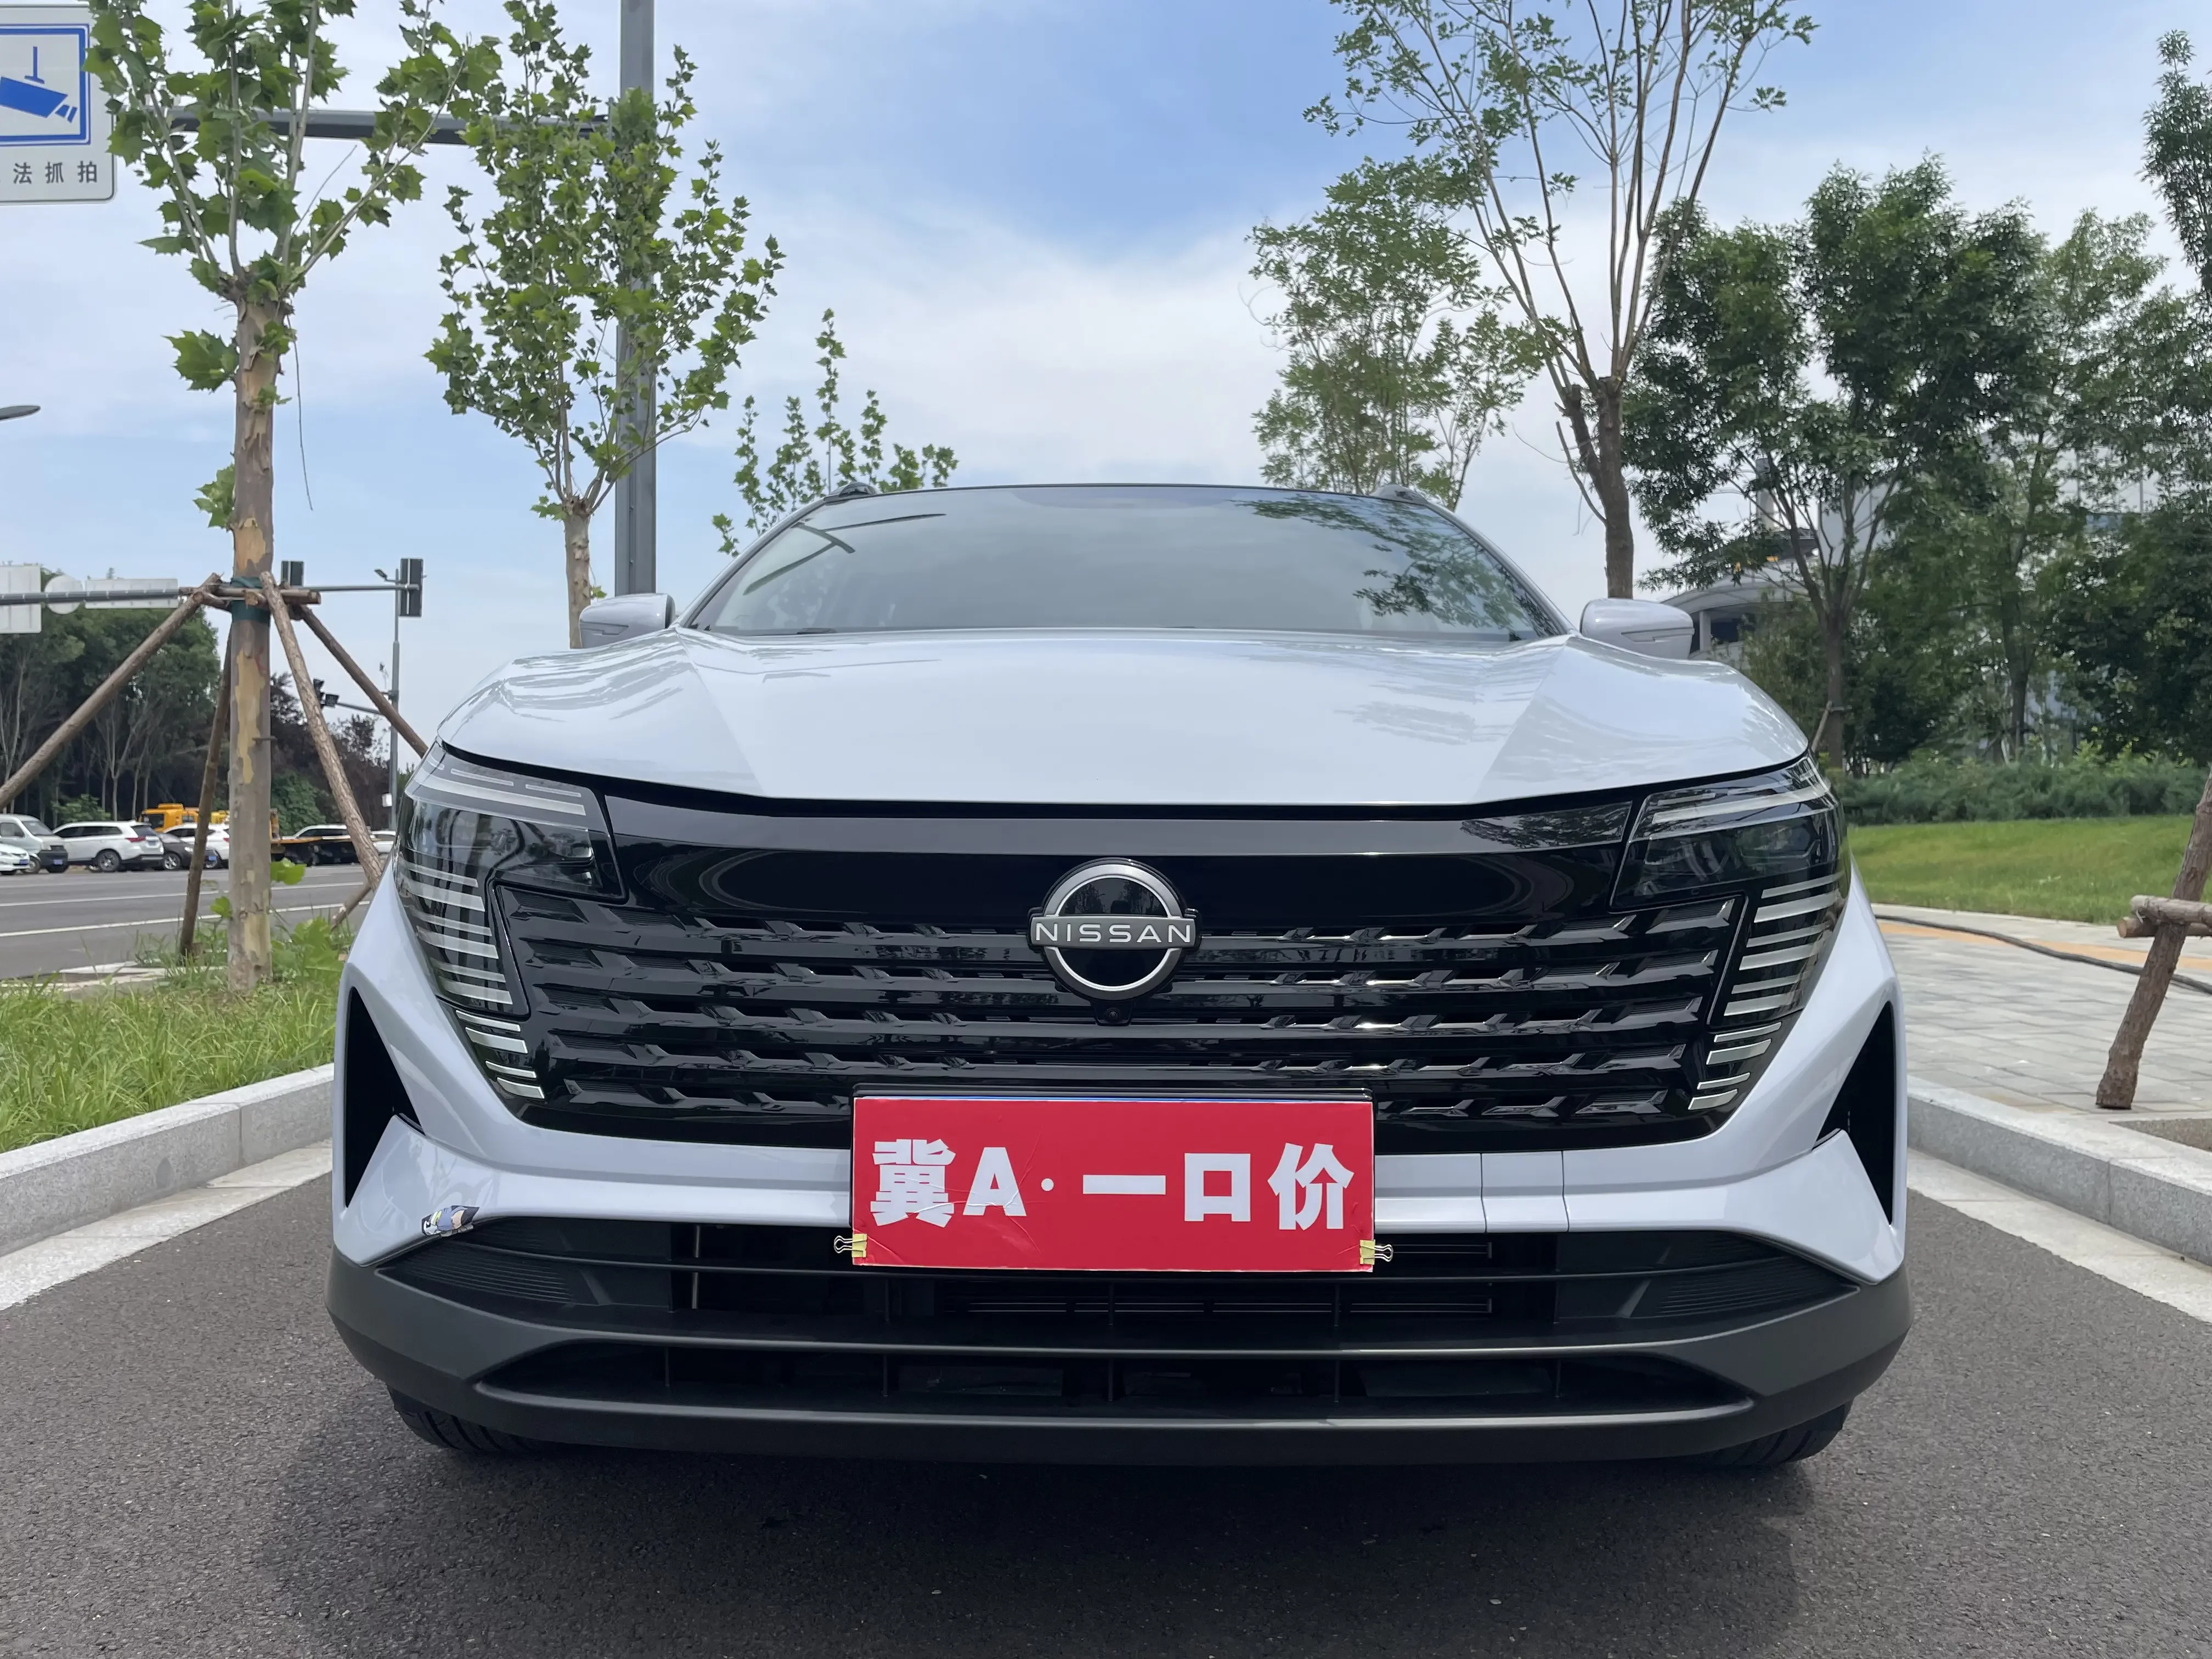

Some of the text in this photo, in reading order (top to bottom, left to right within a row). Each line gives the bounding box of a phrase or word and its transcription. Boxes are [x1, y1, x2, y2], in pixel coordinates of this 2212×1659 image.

[13, 161, 97, 184] 法抓拍
[1036, 923, 1190, 943] NISSAN
